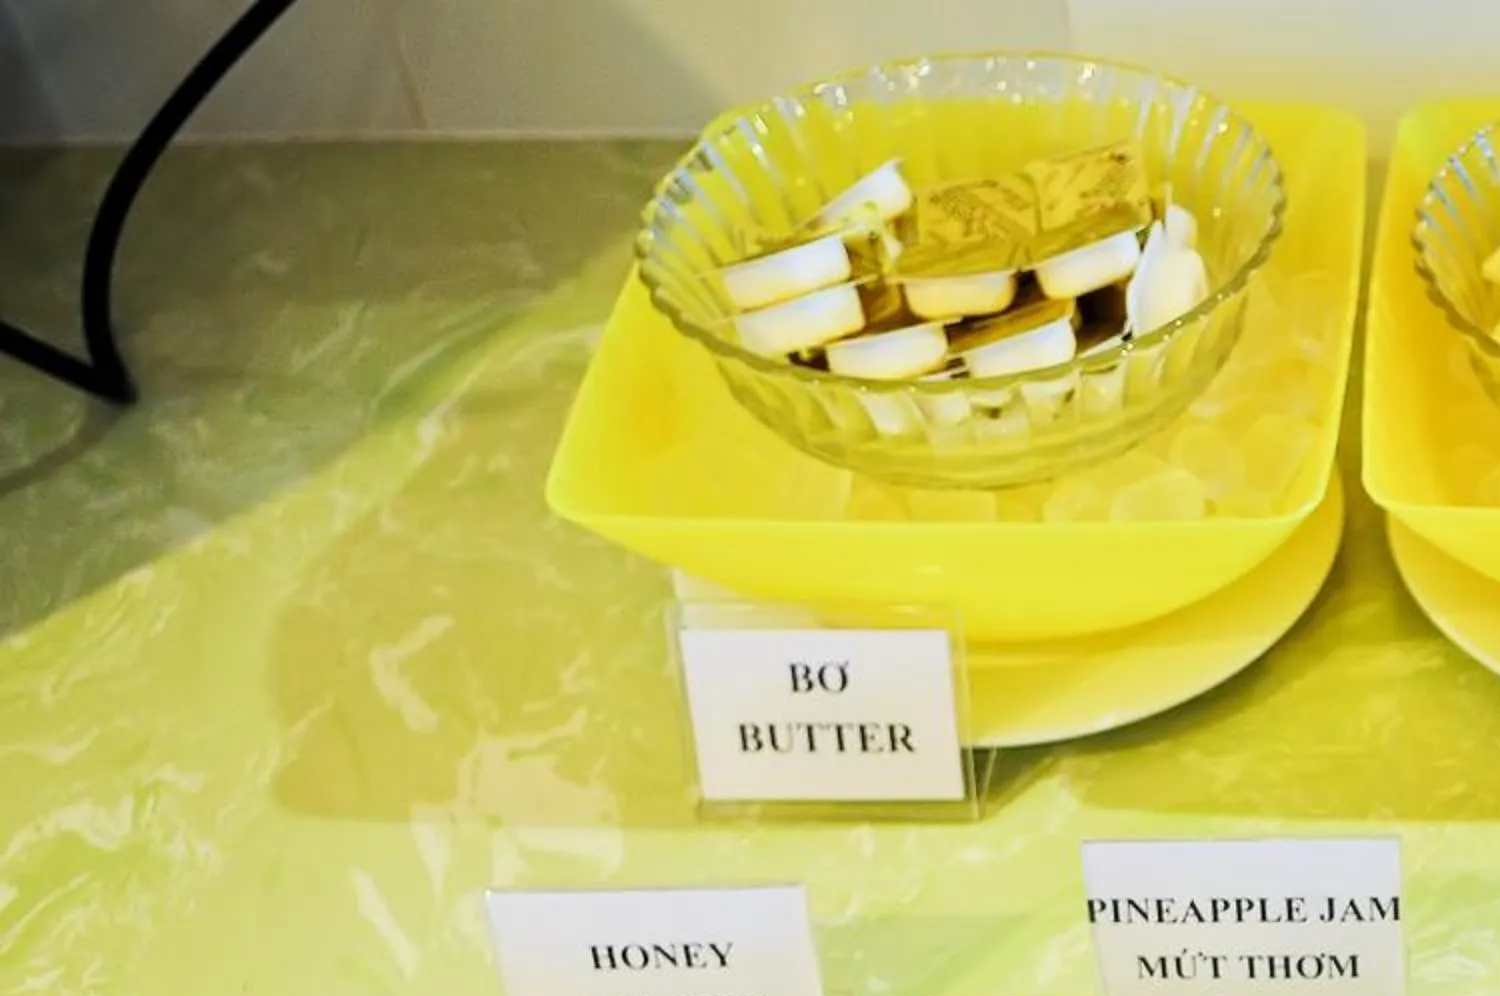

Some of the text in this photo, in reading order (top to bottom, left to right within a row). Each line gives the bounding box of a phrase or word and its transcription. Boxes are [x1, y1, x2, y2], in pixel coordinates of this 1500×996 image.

[738, 722, 915, 753] BUTTER
[1086, 896, 1401, 924] PINEAPPLE JAM
[589, 942, 734, 971] HONEY
[1137, 947, 1360, 980] MỨT THƠM
